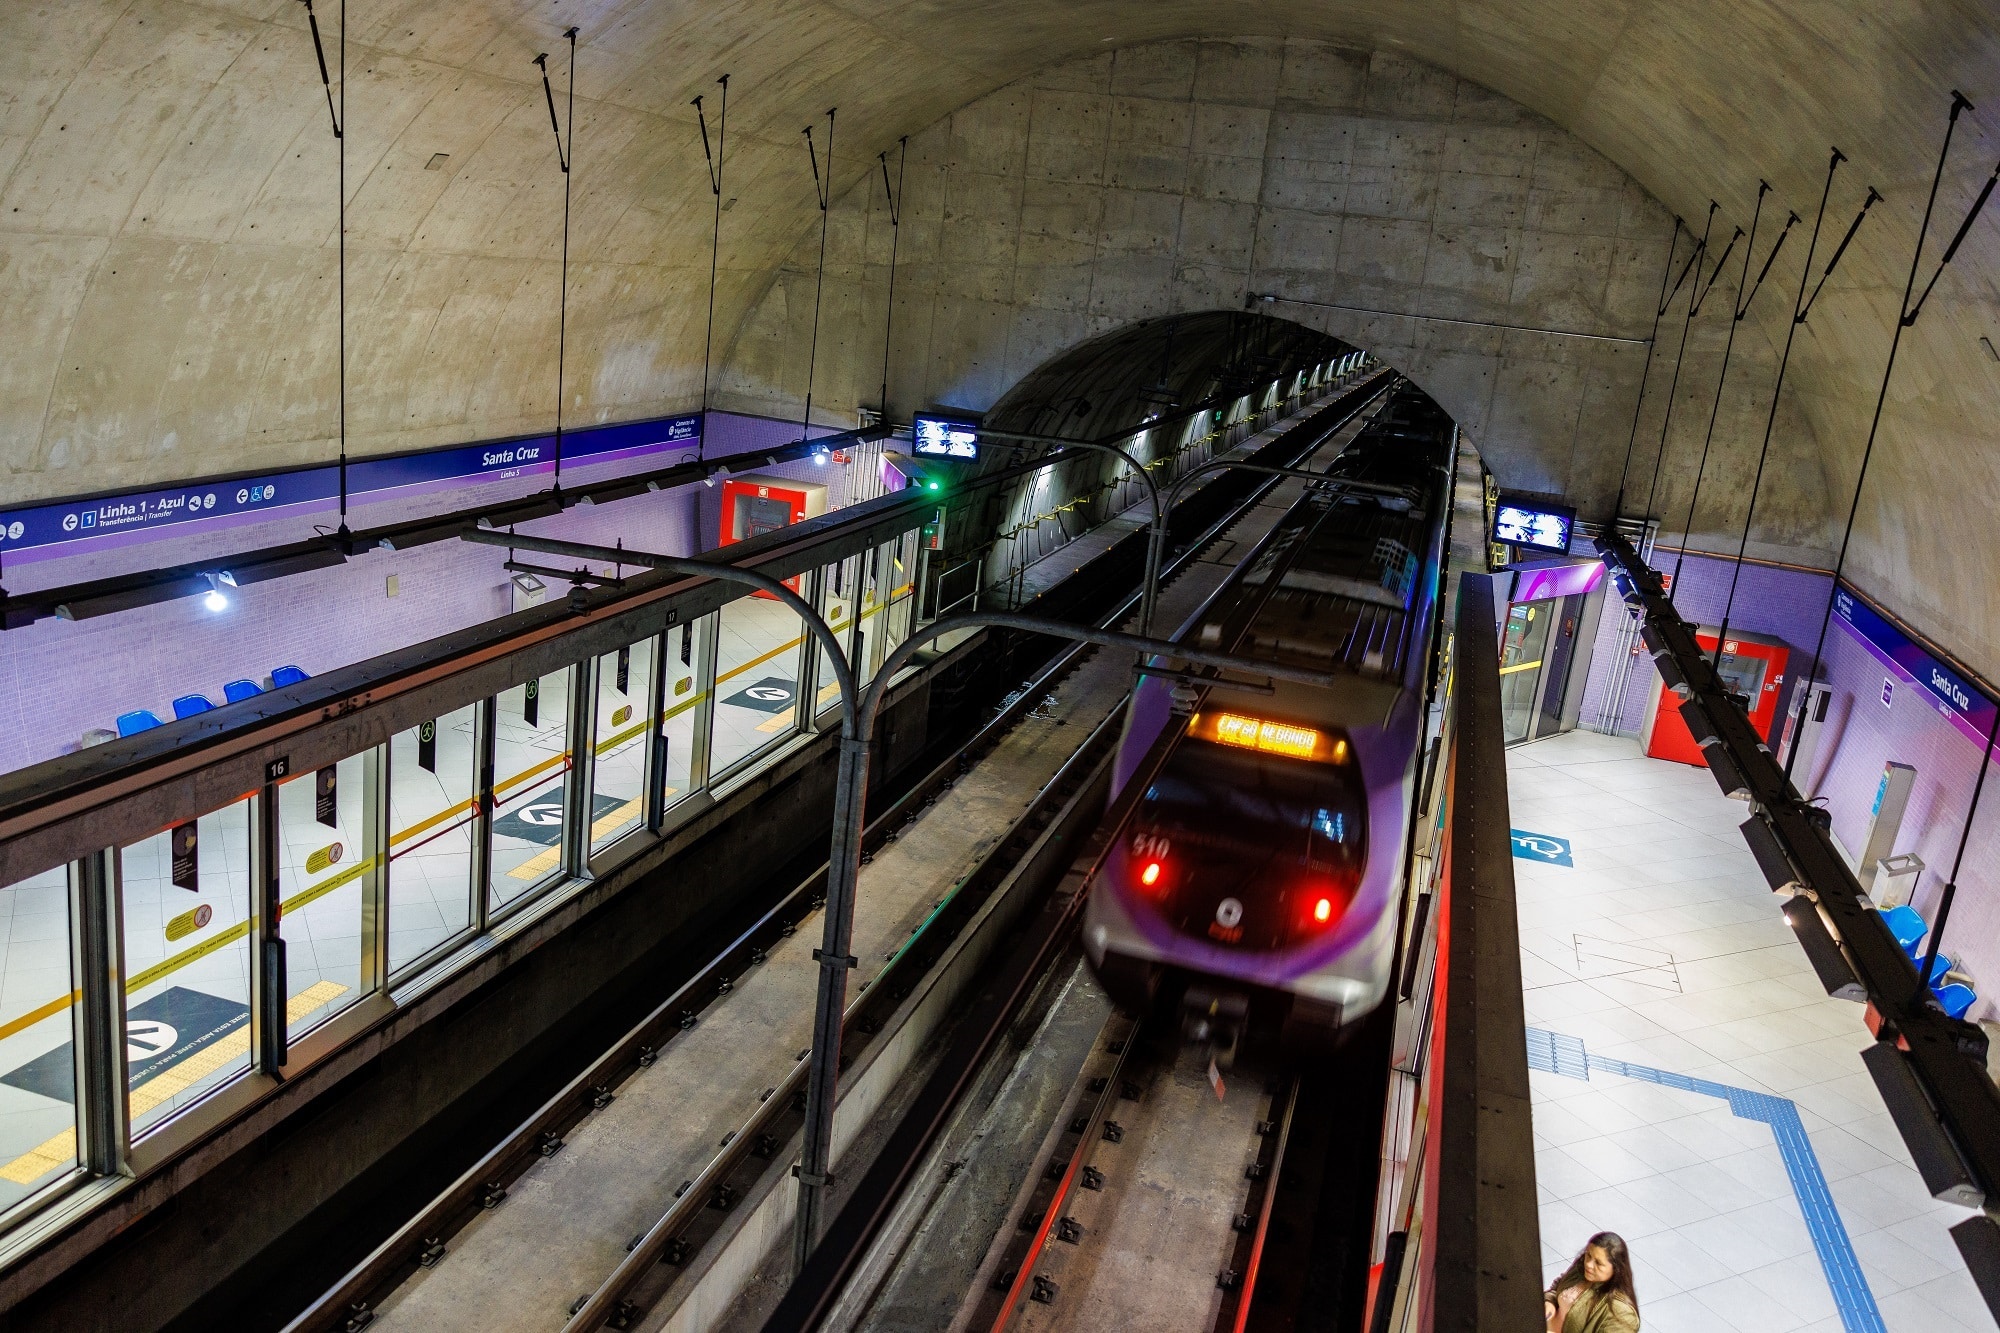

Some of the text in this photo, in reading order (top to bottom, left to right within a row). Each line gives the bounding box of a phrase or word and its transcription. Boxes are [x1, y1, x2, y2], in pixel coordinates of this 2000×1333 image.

[482, 446, 540, 467] Santa Cruz
[500, 469, 520, 479] Linha 5
[101, 504, 135, 519] Linha
[140, 501, 147, 512] 1
[158, 495, 185, 510] Azul
[86, 514, 92, 524] 1
[100, 515, 143, 527] Transferência
[149, 510, 172, 519] Transfer
[668, 612, 675, 622] 17
[1932, 668, 1969, 711] Santa Cruz
[271, 761, 285, 777] 16
[156, 1053, 177, 1066] PARA
